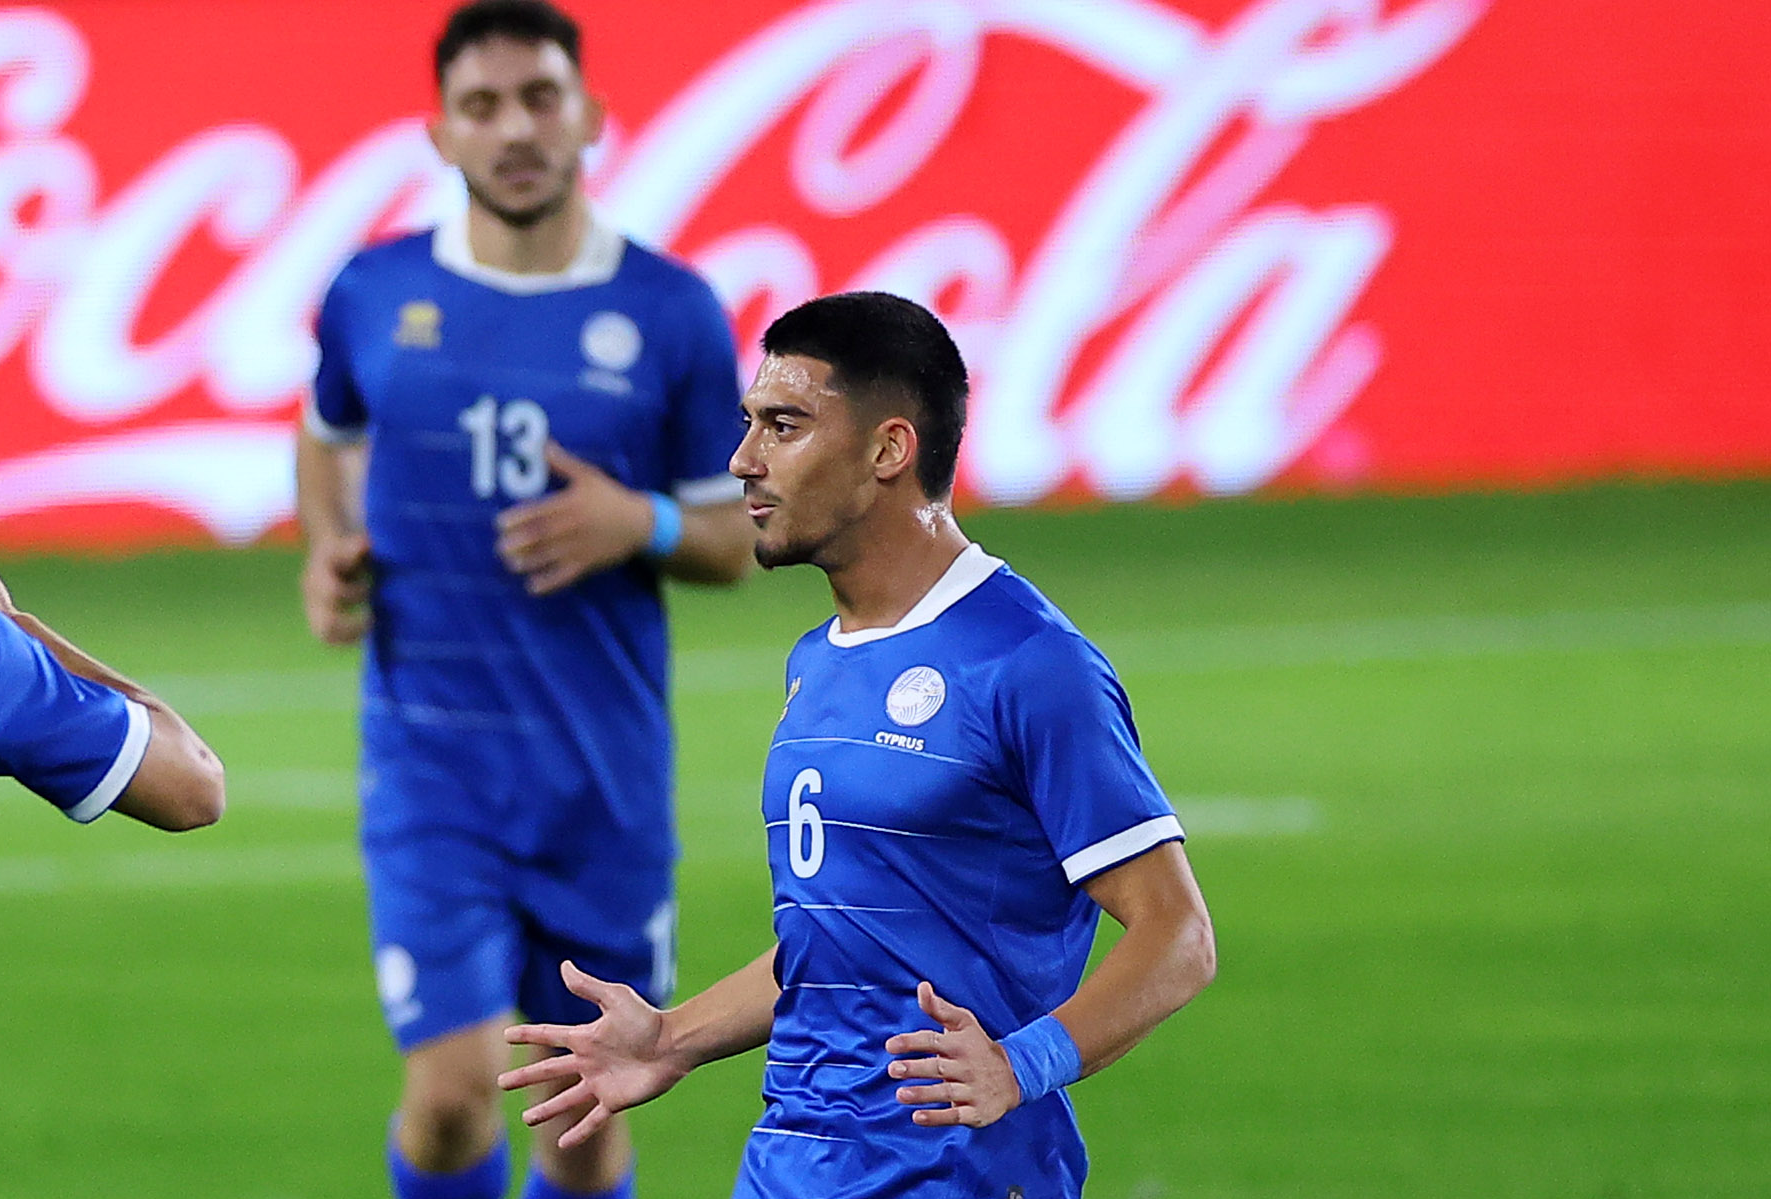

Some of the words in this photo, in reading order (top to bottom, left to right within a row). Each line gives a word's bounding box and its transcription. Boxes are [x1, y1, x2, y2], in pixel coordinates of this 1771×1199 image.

[457, 394, 551, 500] 13
[874, 730, 926, 752] CYPRUS
[788, 767, 825, 879] 6
